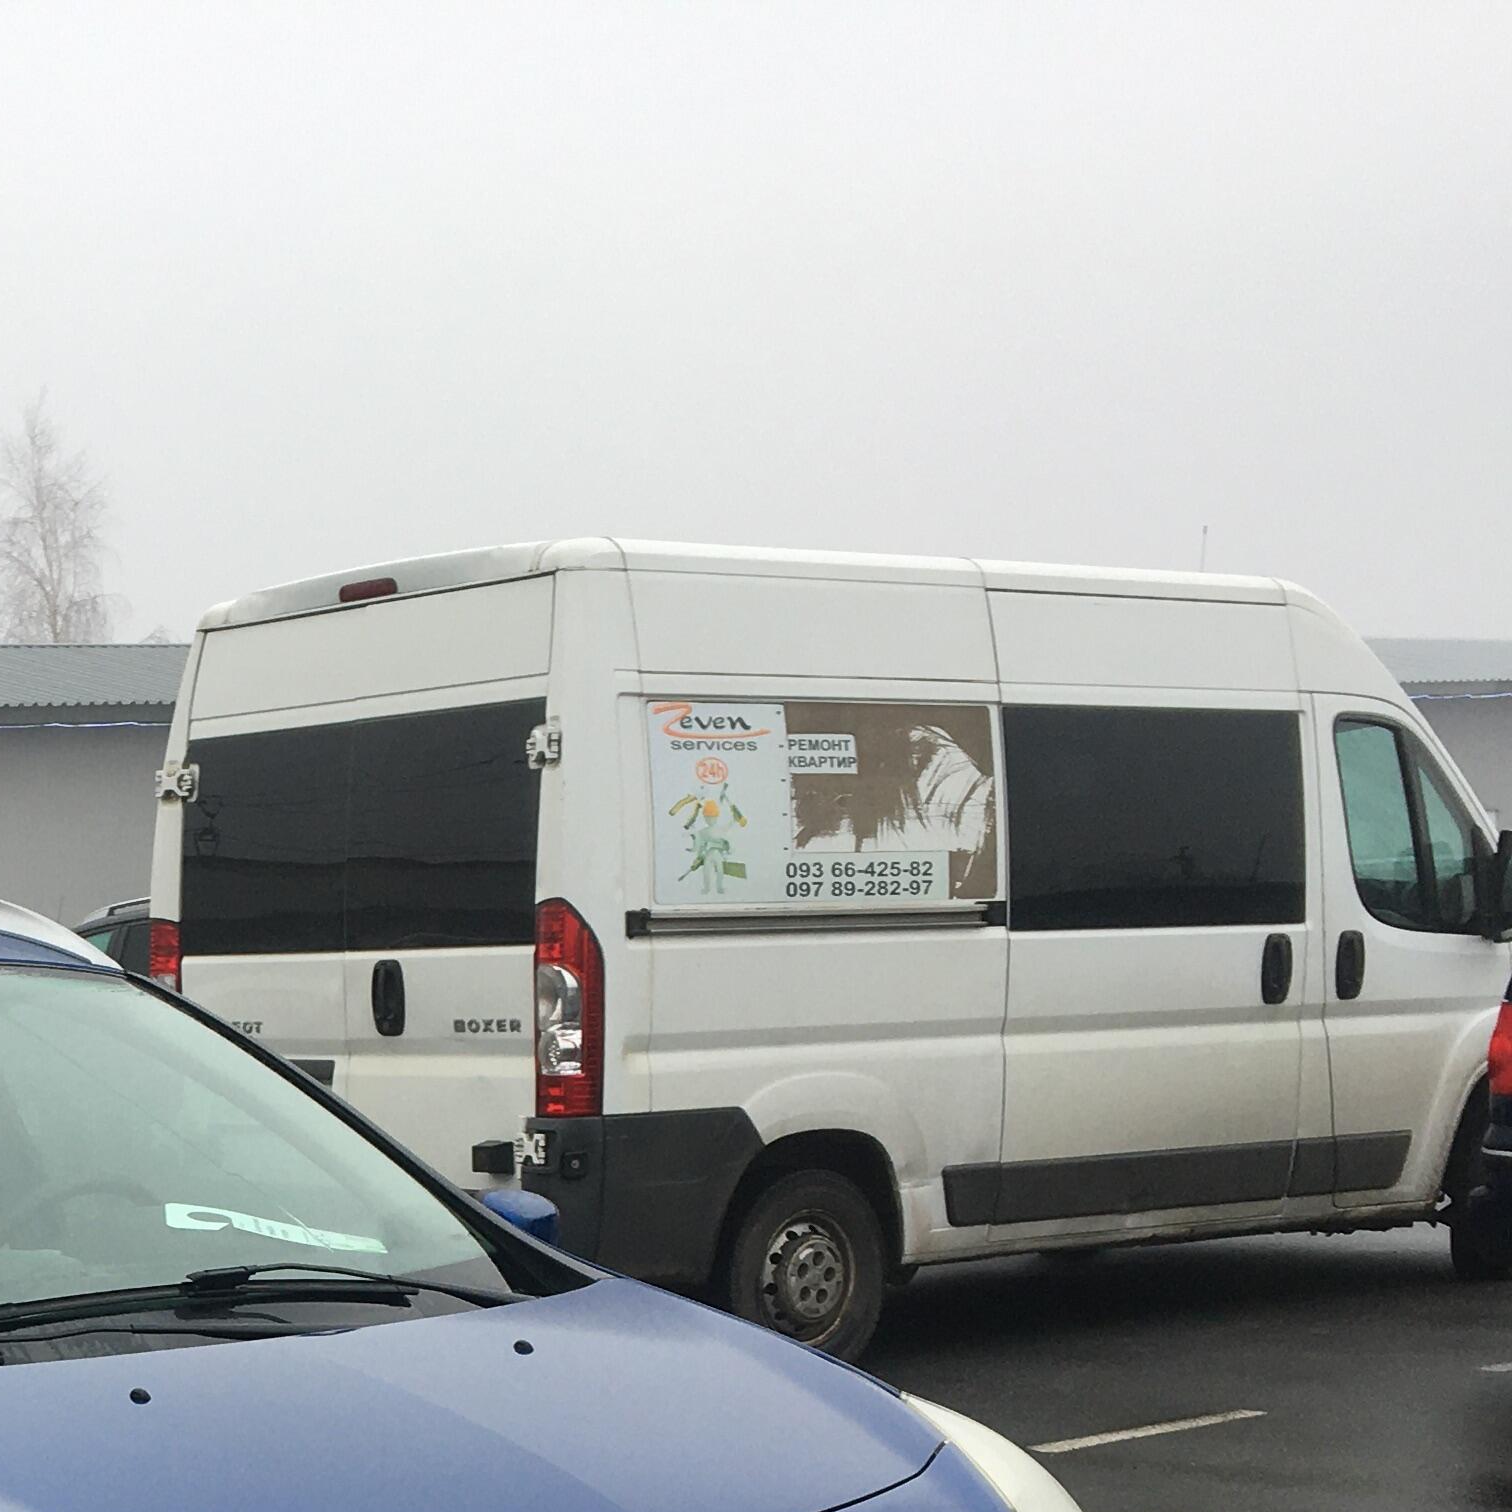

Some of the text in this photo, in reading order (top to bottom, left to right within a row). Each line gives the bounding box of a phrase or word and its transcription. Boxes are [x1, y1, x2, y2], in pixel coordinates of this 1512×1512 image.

[670, 740, 758, 751] services
[788, 739, 850, 751] РЕМОНТ
[788, 756, 857, 768] КВАРТИР
[786, 861, 933, 878] 093 66-425-82
[786, 880, 933, 897] 097 89-282-97
[453, 1019, 521, 1033] BOXER
